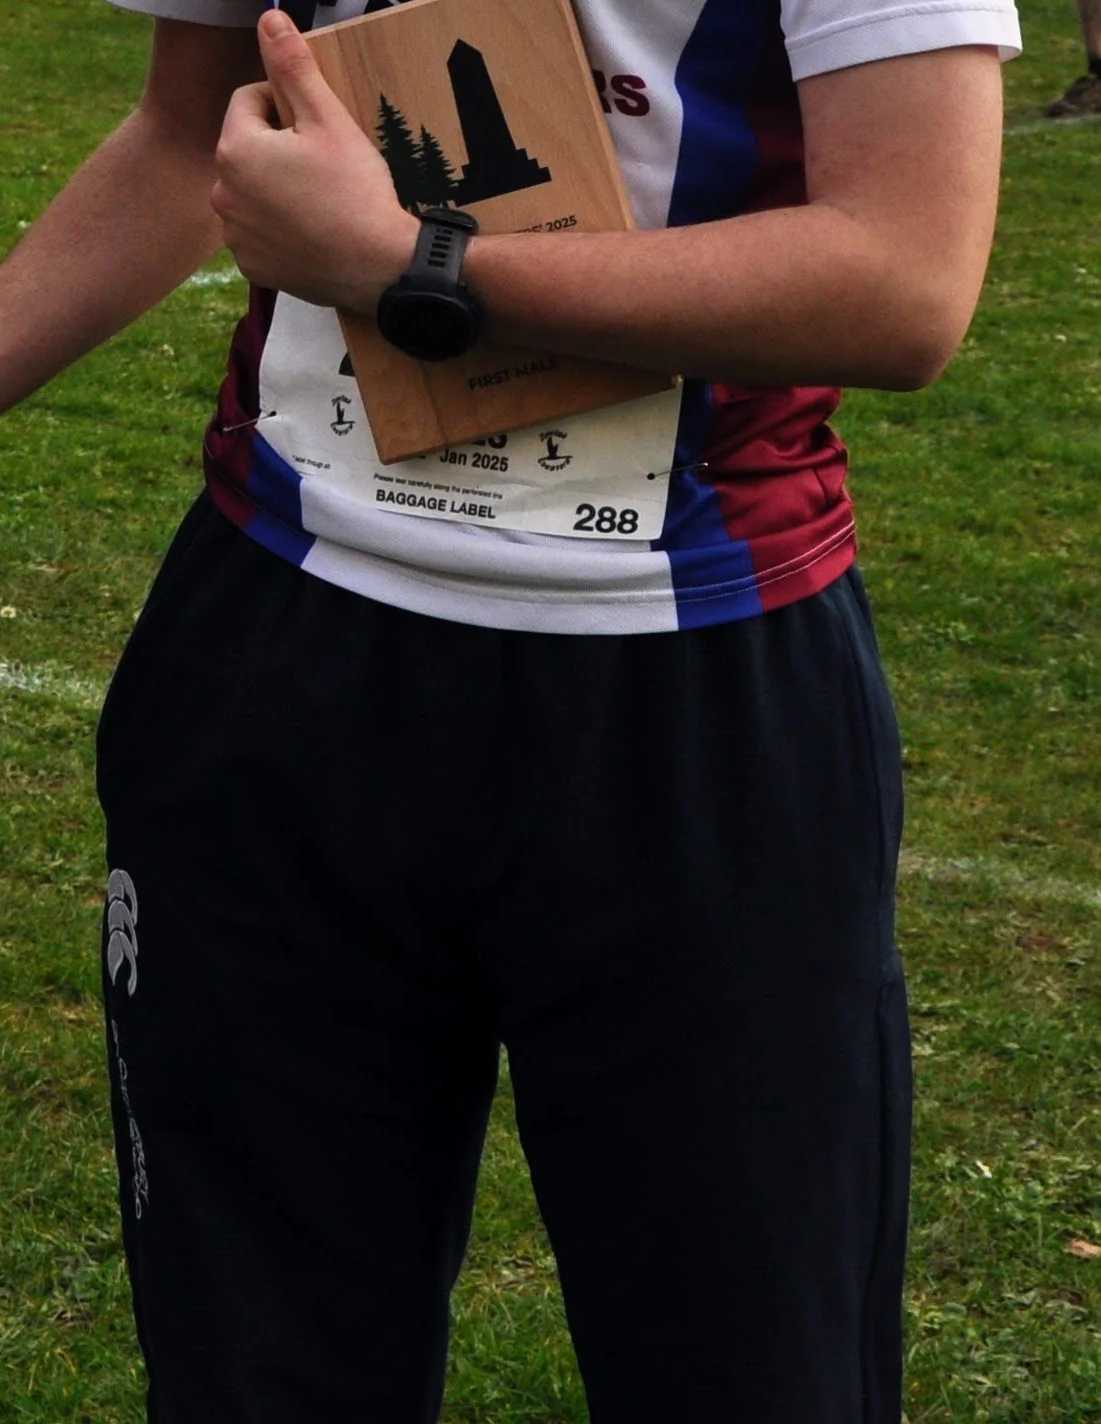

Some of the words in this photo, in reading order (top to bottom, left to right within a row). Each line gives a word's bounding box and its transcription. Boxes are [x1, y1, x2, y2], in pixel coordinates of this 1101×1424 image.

[546, 214, 578, 233] 2025
[467, 369, 511, 392] FIRST
[438, 448, 467, 467] Jan
[472, 452, 509, 472] 2025
[375, 488, 447, 513] BAGGAGE
[449, 499, 497, 519] LABEL
[572, 503, 640, 535] 288
